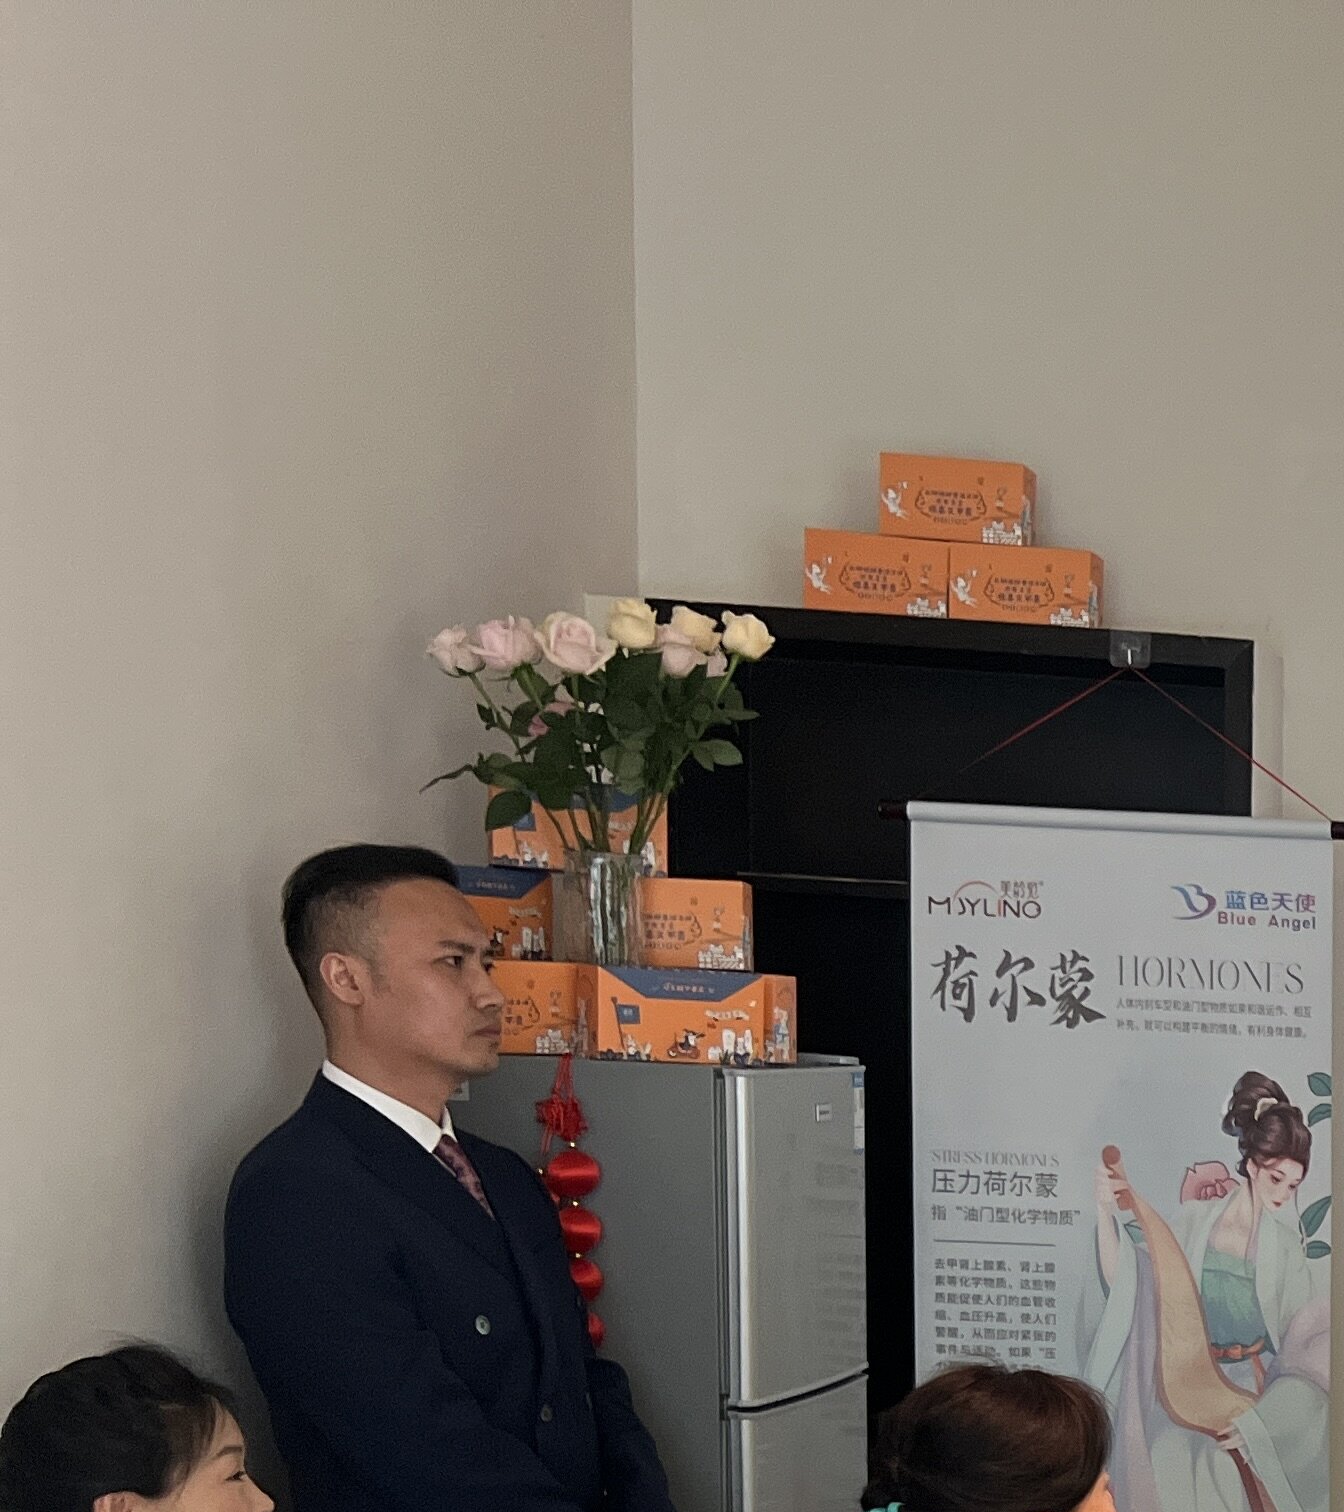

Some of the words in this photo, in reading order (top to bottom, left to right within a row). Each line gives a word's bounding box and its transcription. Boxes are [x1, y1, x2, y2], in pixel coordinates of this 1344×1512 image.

[1224, 890, 1317, 914] 蓝色天使
[1217, 911, 1257, 926] Blue
[1268, 914, 1317, 932] Angel
[930, 944, 1107, 1030] 荷尔蒙
[1118, 954, 1304, 995] HORMONES
[931, 1167, 1059, 1199] 压力荷尔蒙
